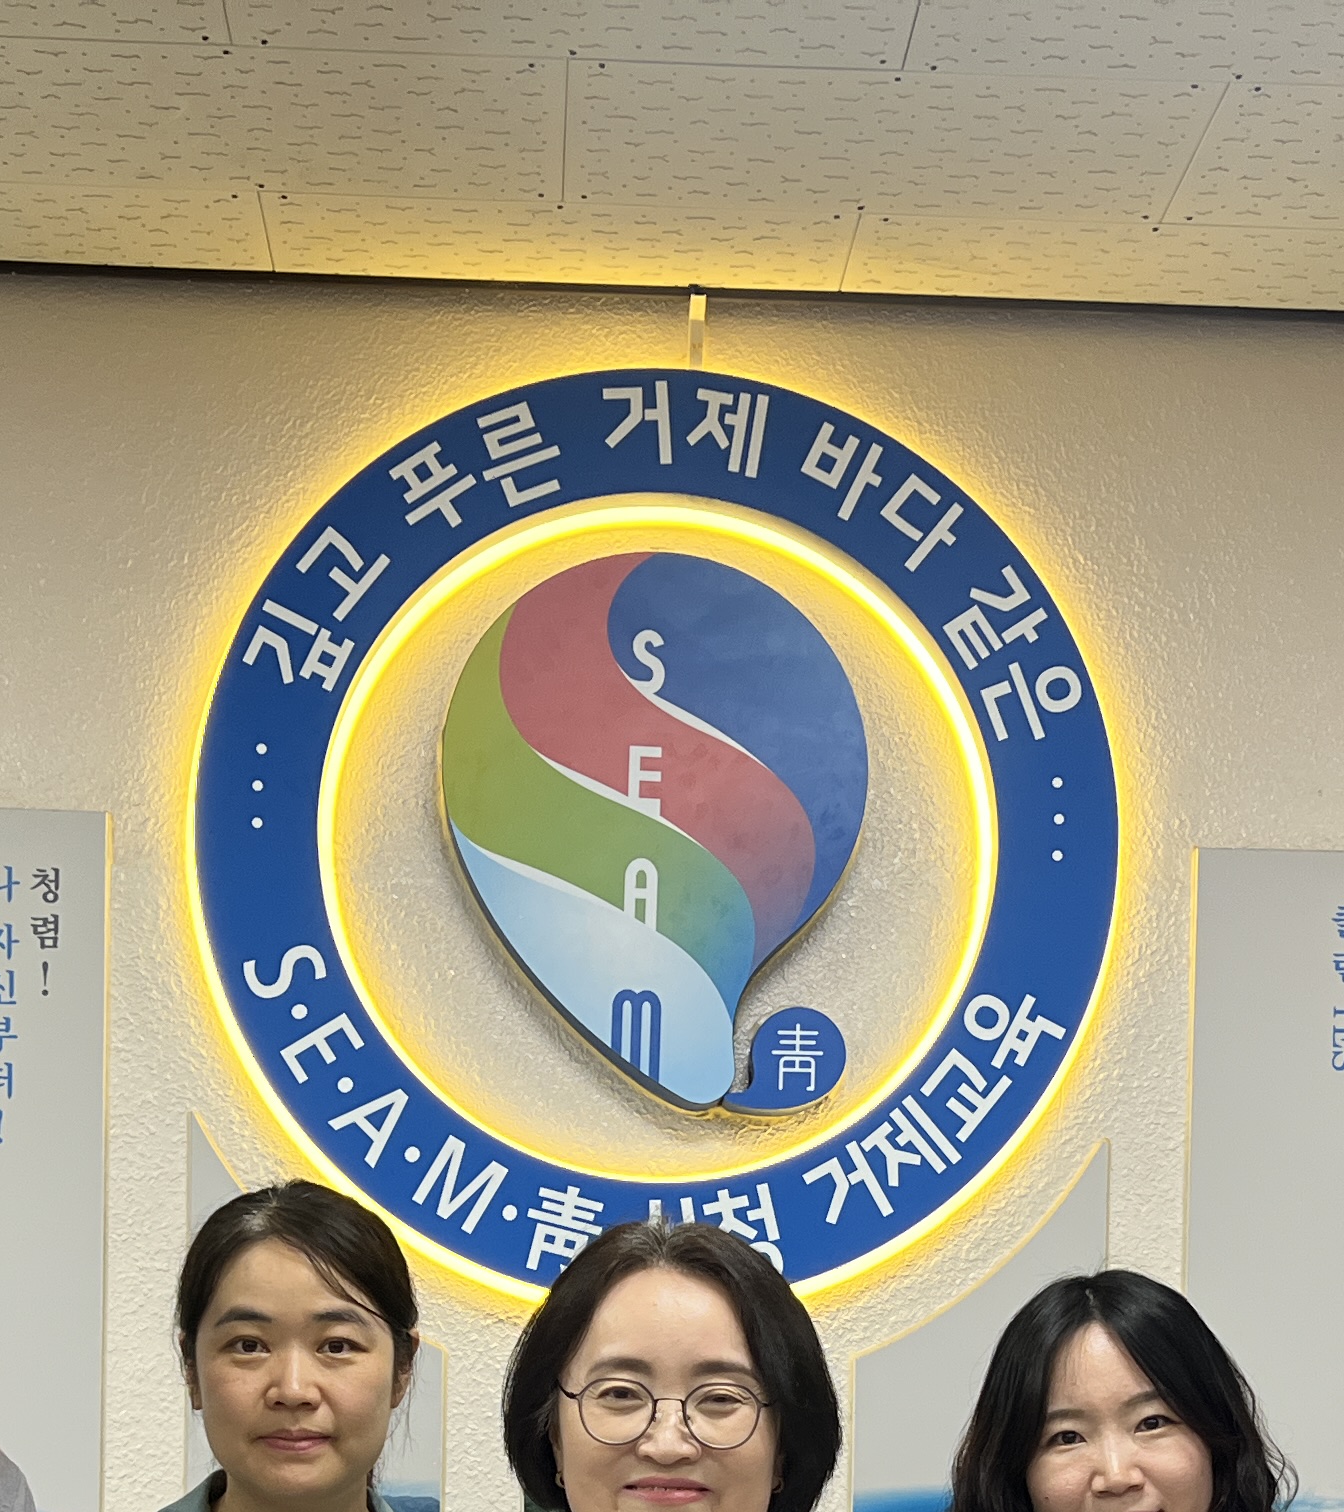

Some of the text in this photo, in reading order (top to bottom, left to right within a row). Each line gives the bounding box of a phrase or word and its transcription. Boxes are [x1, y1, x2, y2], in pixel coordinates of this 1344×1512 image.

[242, 380, 1082, 741] 깊고 푸른 거제 바다 같은
[30, 867, 60, 996] 청렴!
[803, 994, 1068, 1227] 거제교육
